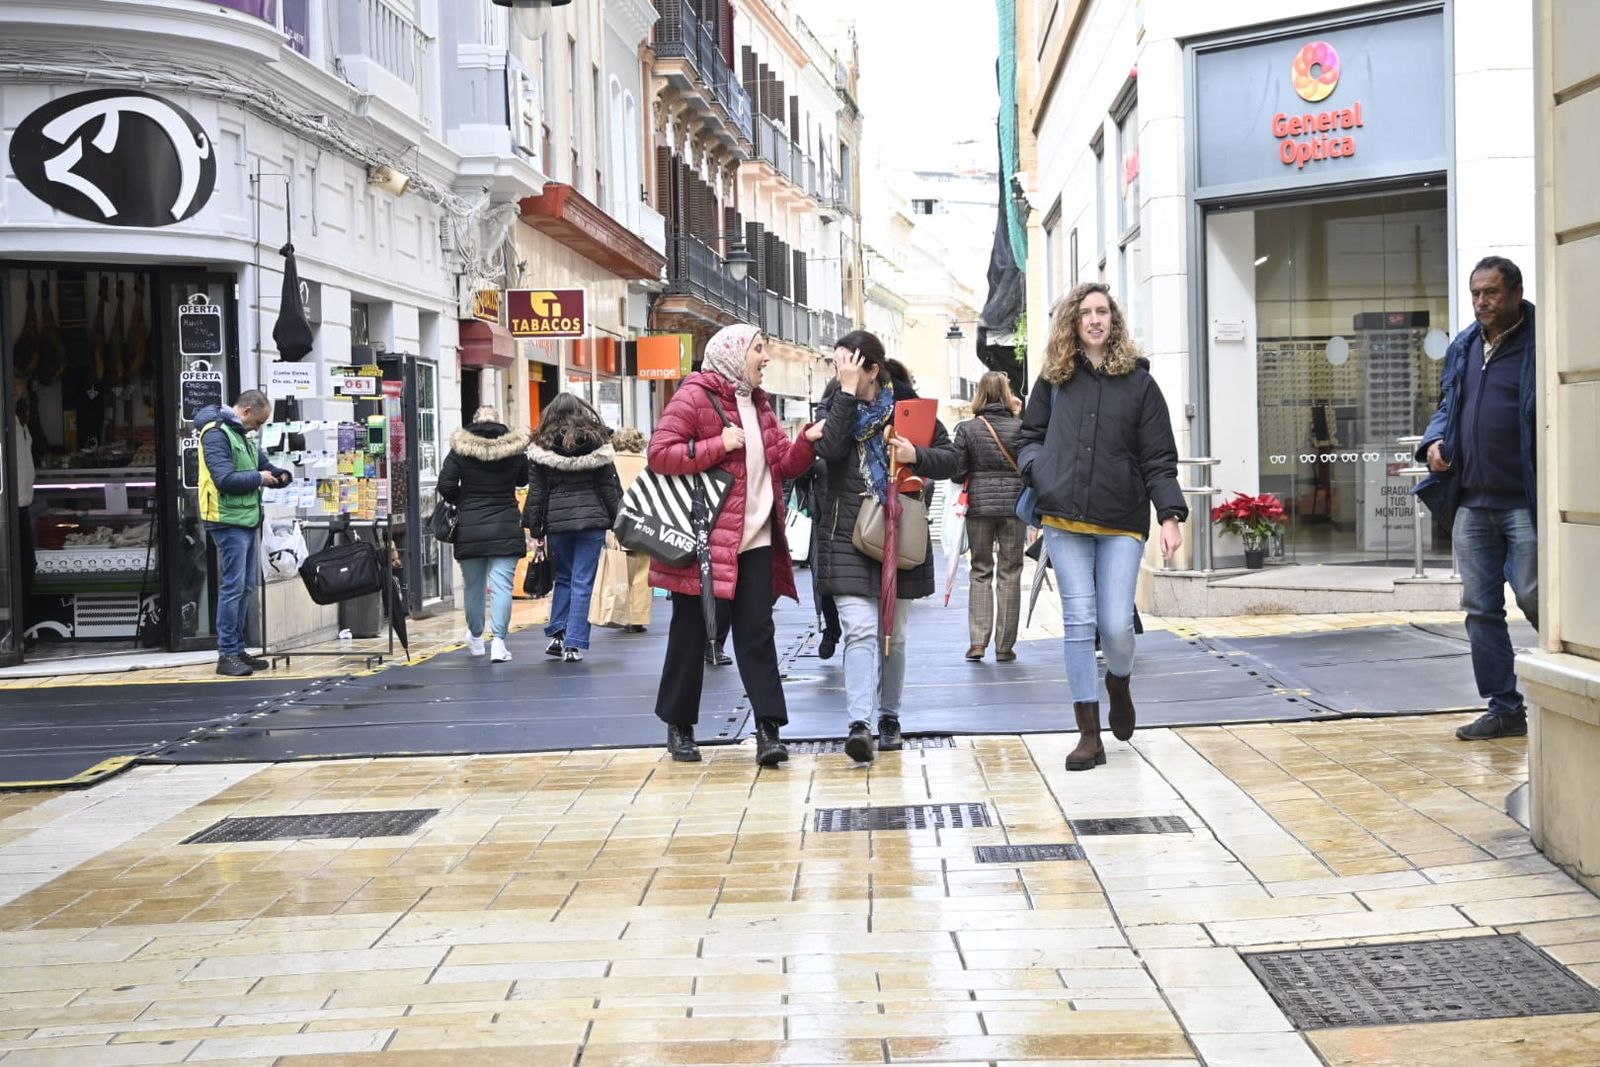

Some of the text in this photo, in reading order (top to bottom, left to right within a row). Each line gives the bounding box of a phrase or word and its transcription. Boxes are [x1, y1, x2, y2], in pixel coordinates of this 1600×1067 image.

[1272, 101, 1363, 138] General
[1279, 134, 1356, 168] Optica
[180, 305, 219, 313] OFERTA
[512, 318, 581, 331] TABACOS
[182, 372, 221, 380] OFERTA
[639, 368, 677, 378] orange
[345, 379, 371, 389] 061
[1380, 485, 1410, 495] GRADÚ
[1390, 496, 1406, 506] TUS
[1375, 507, 1414, 517] MONTURA
[659, 524, 697, 553] VANS
